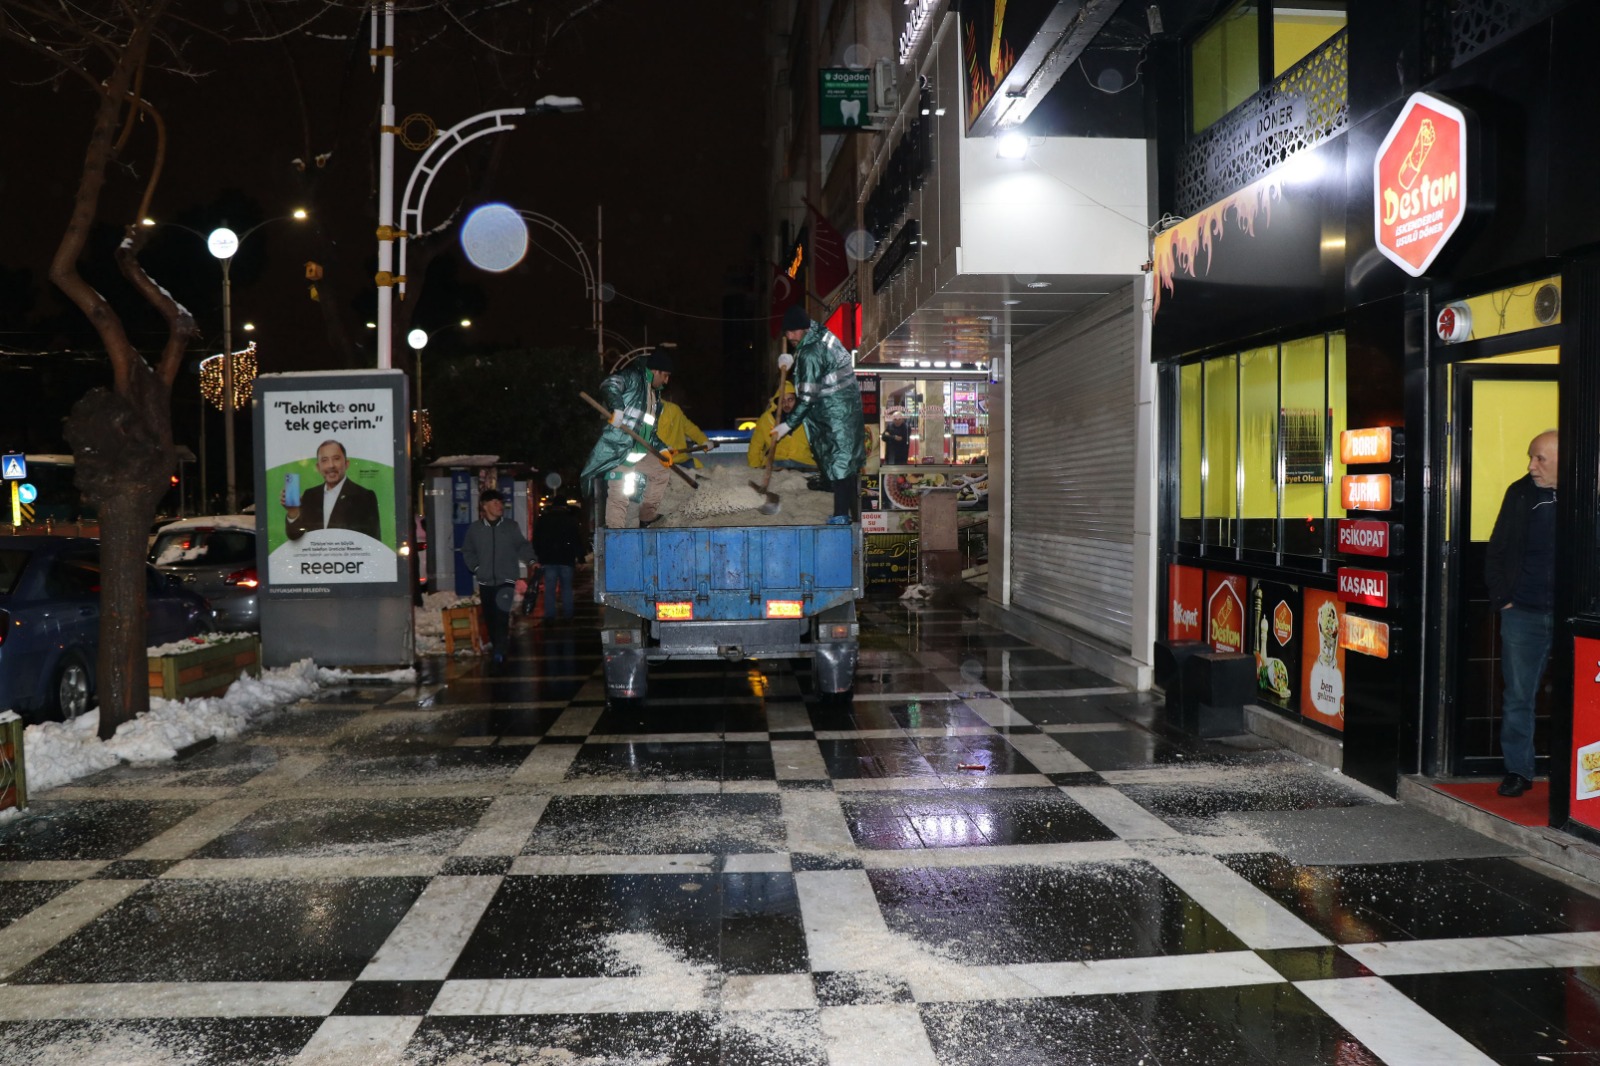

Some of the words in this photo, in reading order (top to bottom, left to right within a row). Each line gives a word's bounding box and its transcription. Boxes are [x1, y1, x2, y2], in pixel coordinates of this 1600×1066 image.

[1214, 129, 1251, 170] DESTAN
[1256, 105, 1293, 137] DÖNER
[1383, 171, 1457, 226] Destan
[1418, 222, 1443, 240] DÖNER
[348, 402, 376, 413] onu
[285, 417, 310, 431] tek
[1352, 435, 1378, 457] BORU
[1302, 474, 1324, 482] Olsun
[1348, 482, 1380, 502] ZURNA
[1340, 524, 1385, 548] PSİKOPAT
[1340, 575, 1384, 597] KAŞARLI
[1211, 618, 1241, 648] Destan
[1349, 624, 1375, 649] ISLAK
[1320, 678, 1333, 694] ben
